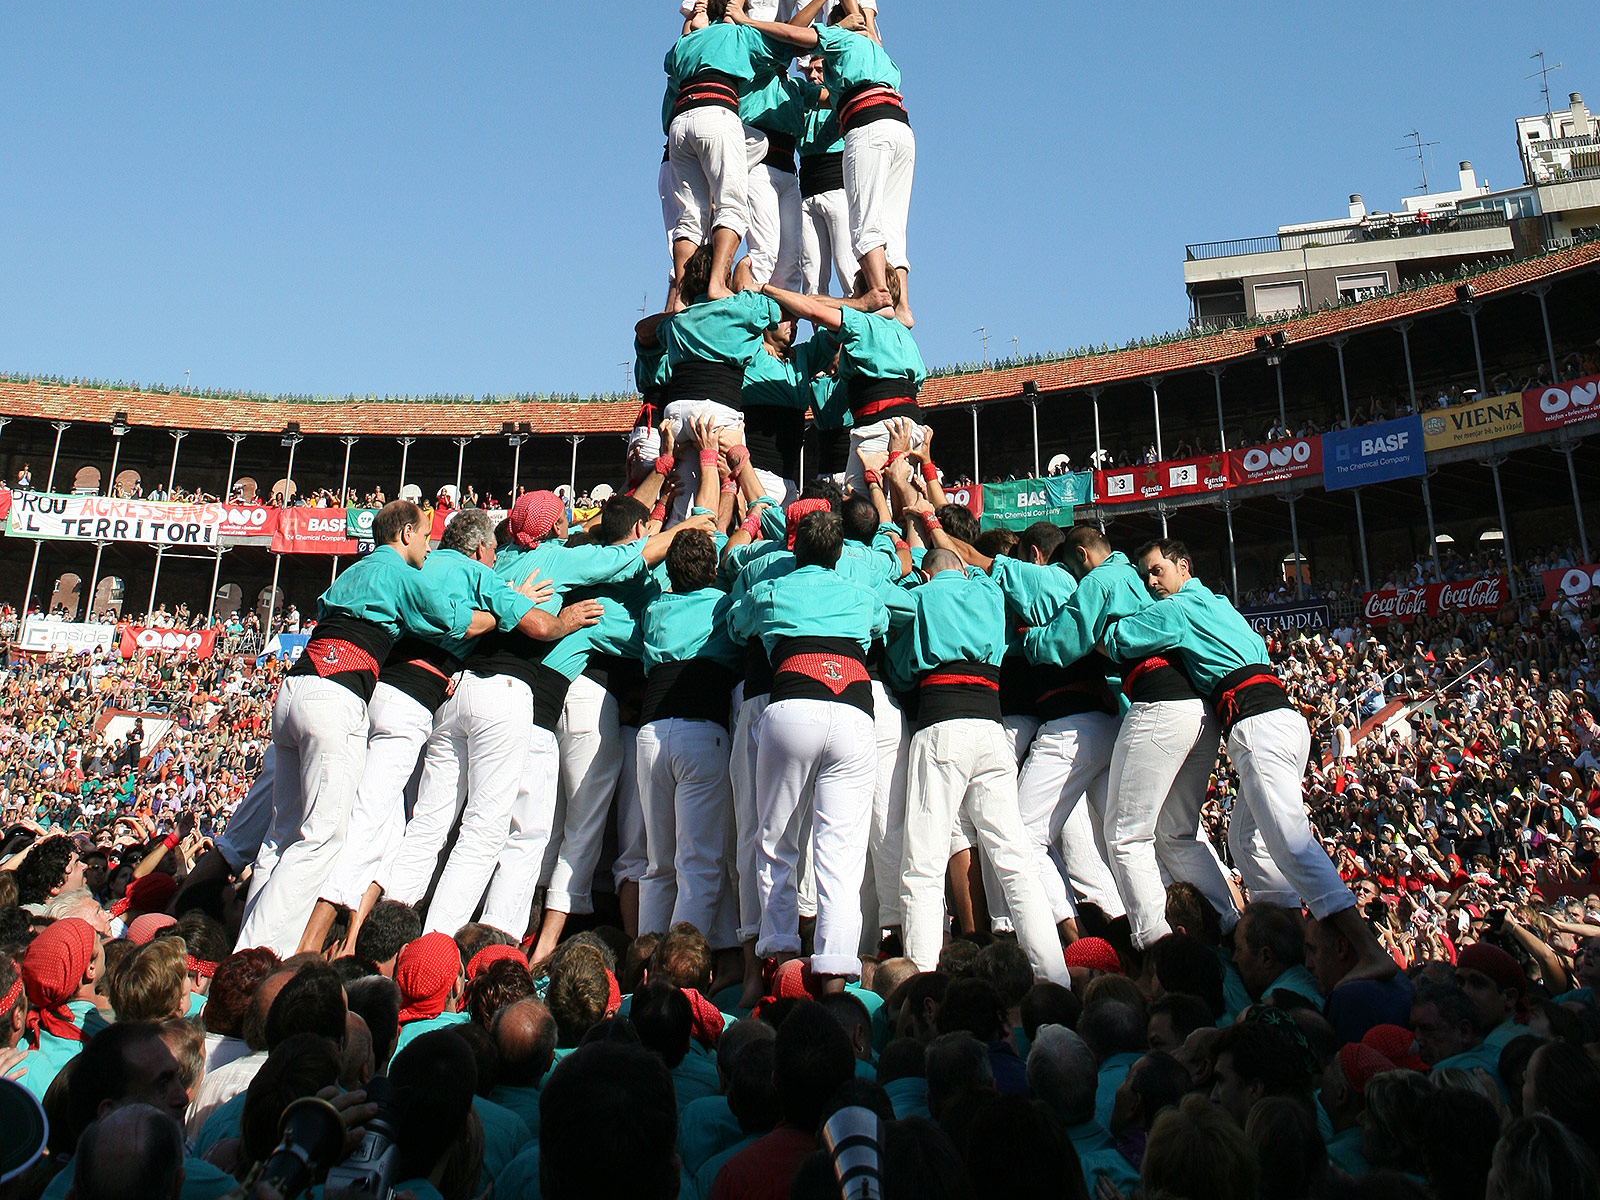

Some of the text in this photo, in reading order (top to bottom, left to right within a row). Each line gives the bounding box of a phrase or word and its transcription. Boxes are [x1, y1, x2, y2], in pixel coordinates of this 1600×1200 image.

[1540, 381, 1600, 414] ON
[1450, 401, 1522, 430] VIENA
[1453, 433, 1463, 441] Per
[1494, 425, 1503, 433] bo
[1361, 431, 1409, 456] BASF
[1243, 441, 1311, 472] ONO
[1349, 459, 1379, 471] Chemical
[1380, 455, 1411, 466] Company
[1017, 490, 1047, 508] BAS
[80, 498, 220, 525] AGRESSIONS
[219, 508, 267, 526] NO
[993, 512, 1003, 520] The
[1005, 510, 1031, 519] Chemical
[61, 518, 212, 543] TERRITORI
[307, 518, 347, 532] BASF
[321, 534, 347, 542] Company
[51, 627, 109, 644] inside
[136, 629, 203, 650] ONO
